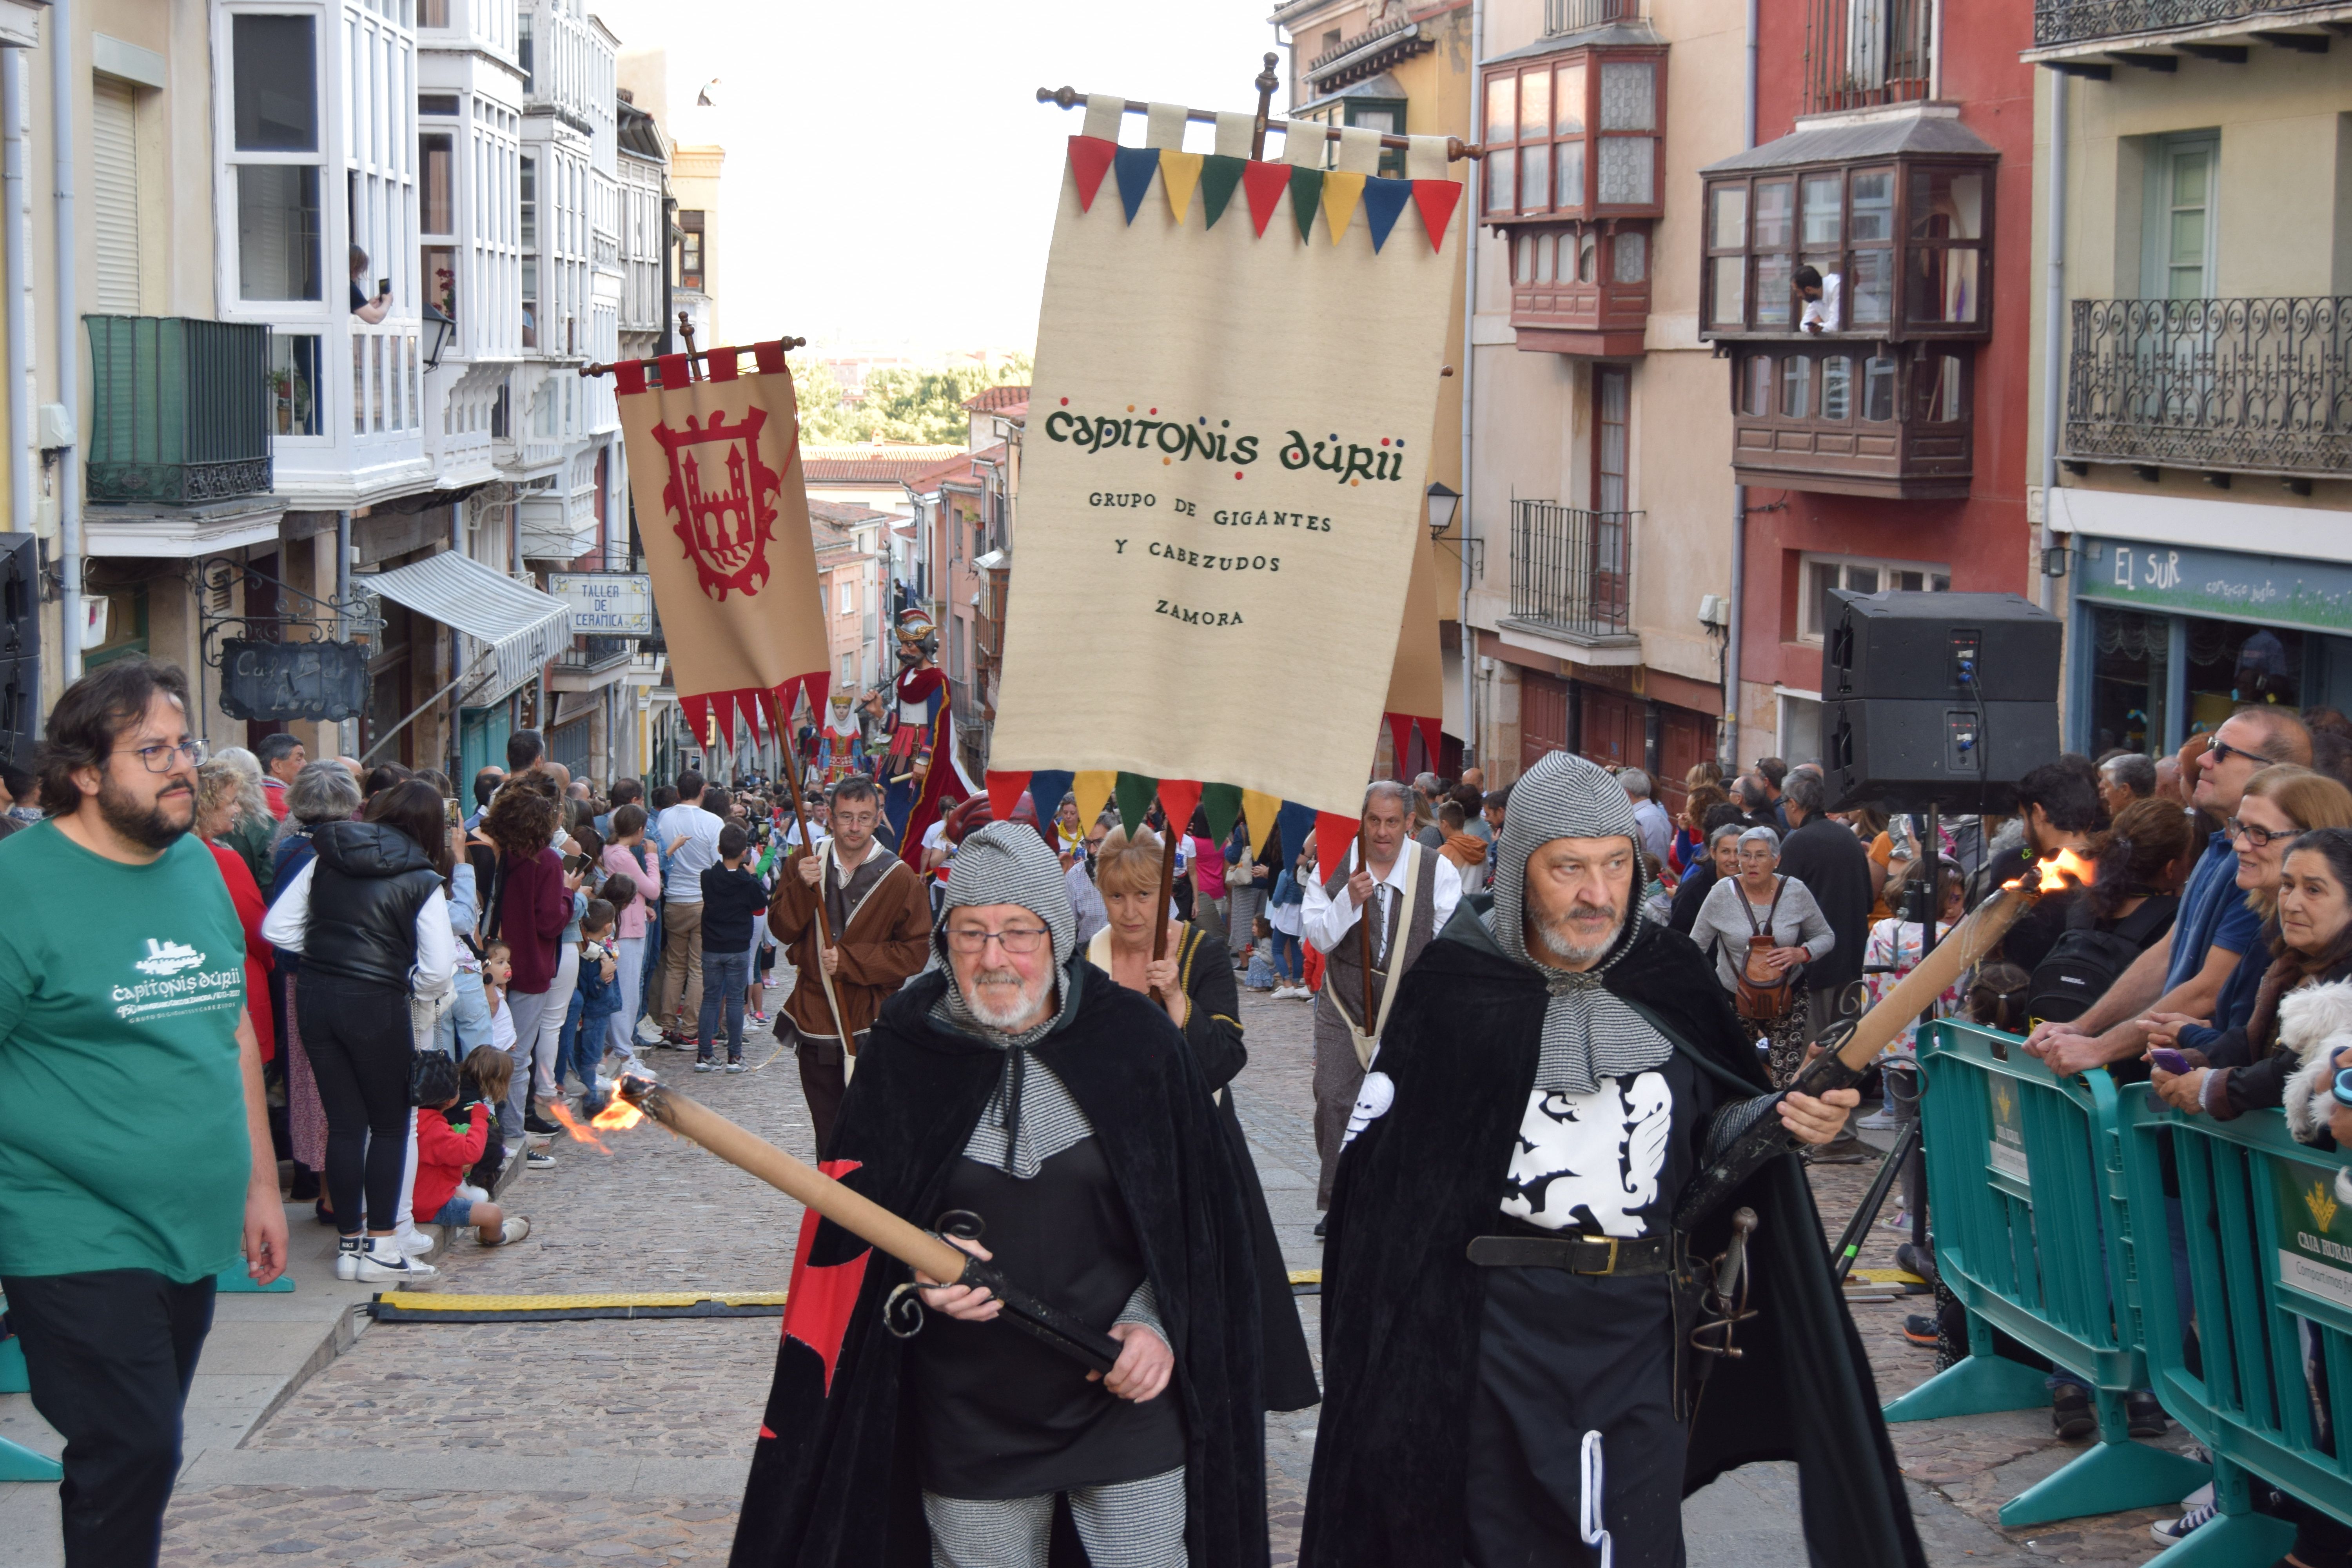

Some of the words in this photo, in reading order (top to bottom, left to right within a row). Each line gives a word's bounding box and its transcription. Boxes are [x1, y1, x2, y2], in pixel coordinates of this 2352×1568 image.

[1089, 492, 1157, 508] GRUPO
[1174, 497, 1197, 517] DE
[1214, 510, 1332, 533] GIGANTES
[1114, 539, 1129, 554] Y
[1149, 542, 1281, 572] CABEZUDOS
[2114, 547, 2136, 591] EL
[2144, 550, 2181, 590] SUR
[582, 584, 619, 597] TALLER
[595, 599, 607, 612] DE
[1154, 598, 1245, 627] ZAMORA
[576, 614, 624, 627] CERAMICA
[2298, 1231, 2320, 1253] CAJA
[2297, 1261, 2343, 1289] Compartimos
